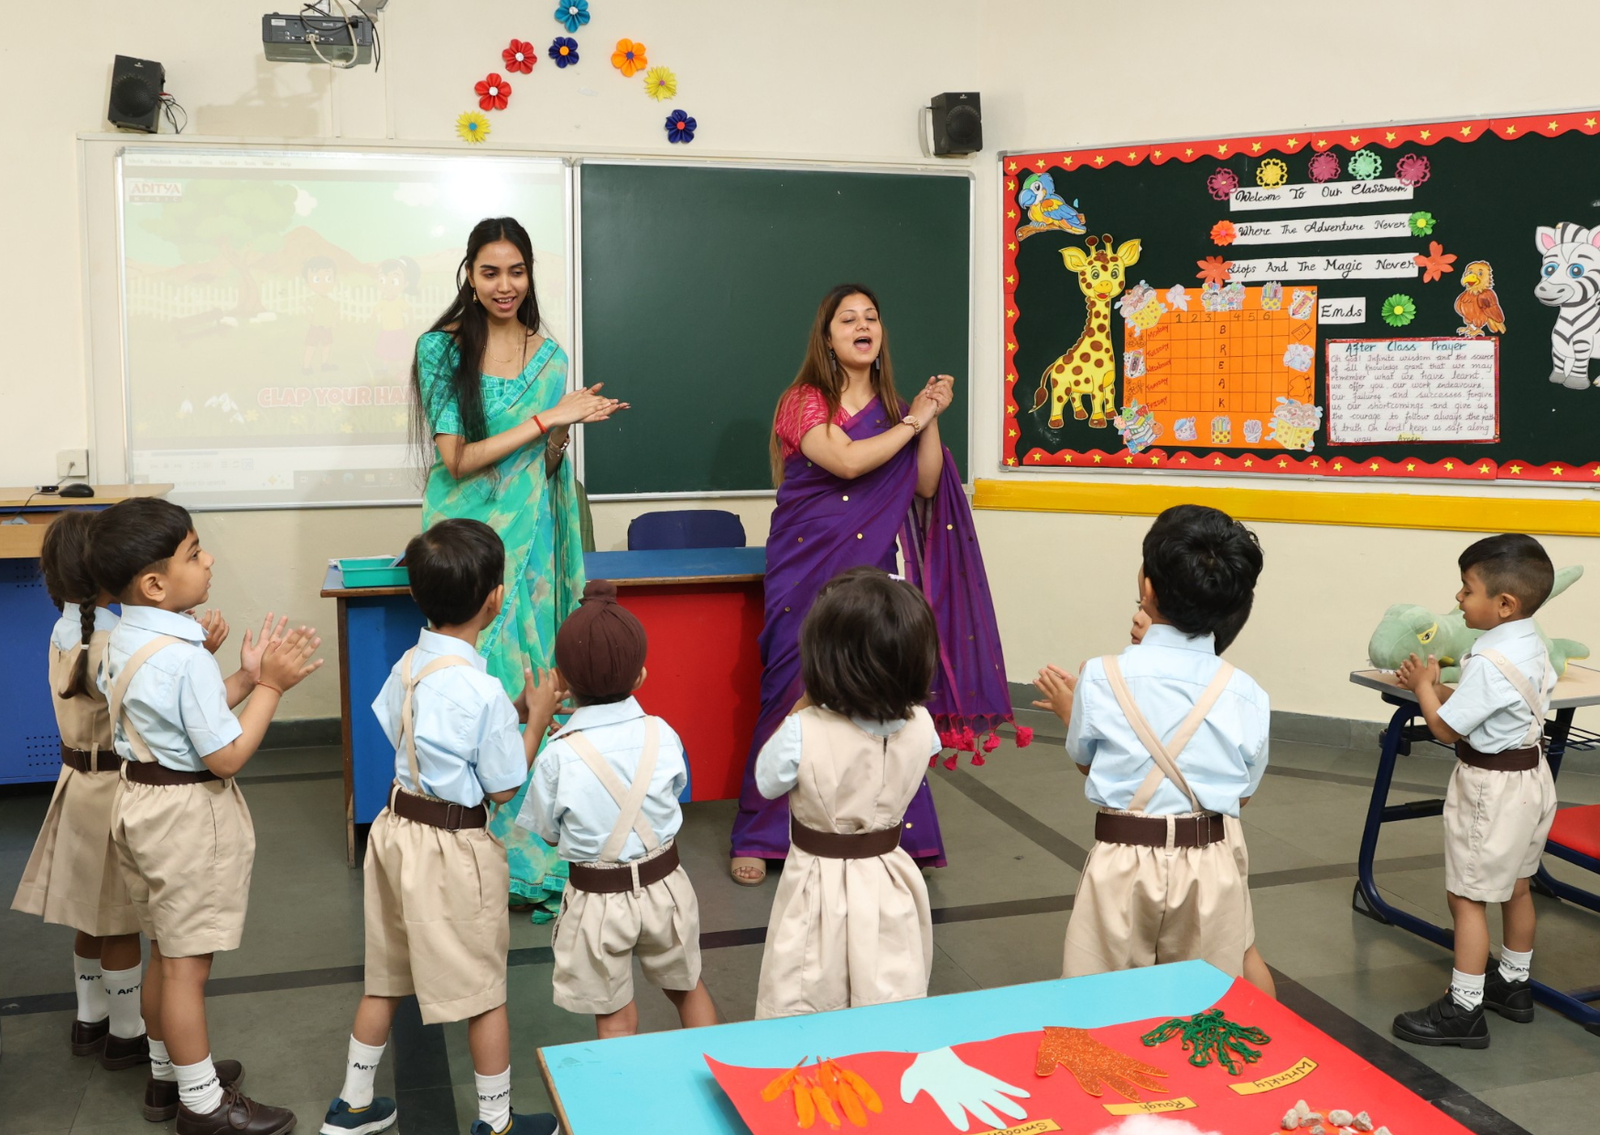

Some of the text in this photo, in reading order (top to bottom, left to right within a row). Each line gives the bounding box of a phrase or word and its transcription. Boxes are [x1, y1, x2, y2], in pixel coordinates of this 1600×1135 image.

[131, 182, 180, 194] ADITYA
[1235, 184, 1408, 202] Welcome To Our Classroom
[1238, 220, 1406, 237] Where The Adventure Never
[1227, 258, 1416, 279] Stops And The Magic Never
[1175, 311, 1271, 324] 1 2 3 4 5 6
[1320, 304, 1363, 318] Ends
[1346, 341, 1468, 356] After Class Prayer
[1400, 354, 1431, 362] wisdom
[1344, 364, 1358, 372] all
[1404, 363, 1424, 374] grant
[1430, 362, 1446, 370] that
[1472, 364, 1493, 373] may
[1331, 373, 1366, 381] remember
[1420, 371, 1444, 380] have
[1348, 382, 1365, 392] offer
[1412, 381, 1431, 391] work
[258, 387, 311, 408] CLAP
[314, 386, 372, 406] YOUR
[1352, 392, 1382, 403] failures
[1390, 391, 1408, 399] and
[1368, 402, 1424, 414] shortcomings
[1454, 403, 1472, 414] give
[1477, 404, 1488, 413] us
[1332, 412, 1344, 420] the
[1350, 414, 1381, 424] courage
[1390, 412, 1398, 420] to
[1404, 412, 1430, 424] follow
[1434, 411, 1462, 424] always
[1466, 412, 1480, 420] the
[1445, 422, 1462, 434] safe
[1467, 422, 1490, 435] along
[1252, 1061, 1313, 1088] Wrinkly
[1140, 1100, 1186, 1112] Rough
